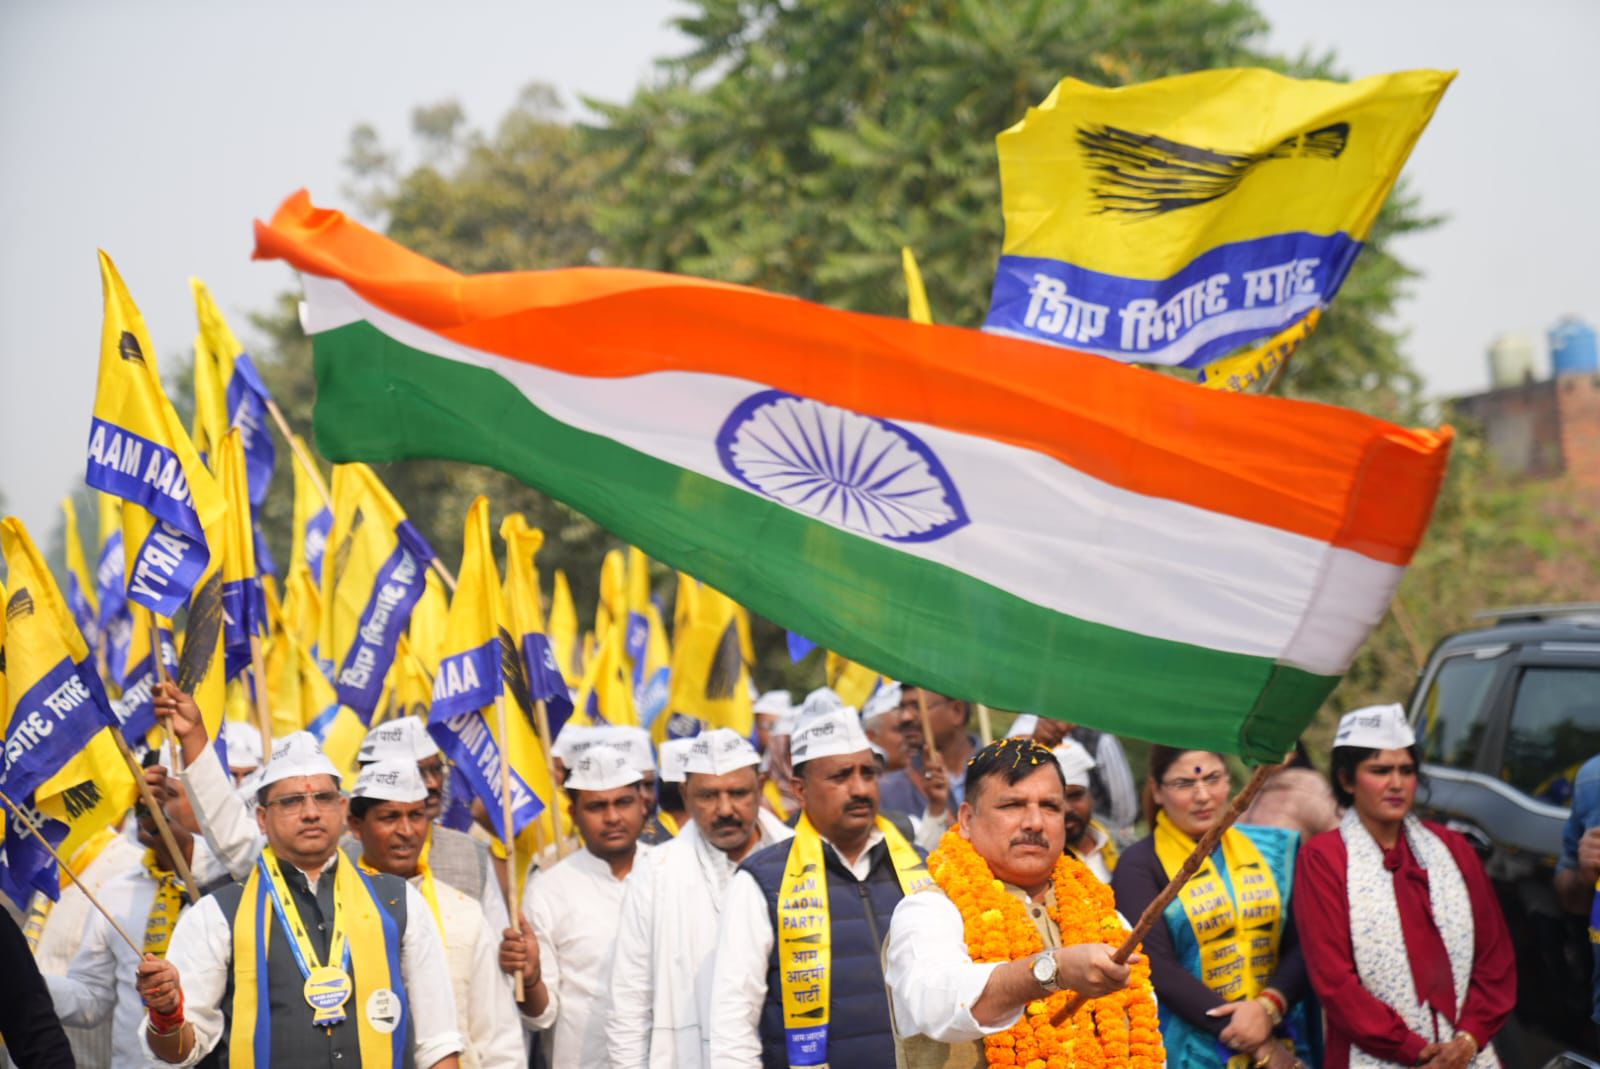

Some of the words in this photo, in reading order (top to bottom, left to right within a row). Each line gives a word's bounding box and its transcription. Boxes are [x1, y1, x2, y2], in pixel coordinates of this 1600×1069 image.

[88, 425, 143, 478] AAM
[792, 879, 816, 893] AAM
[783, 898, 824, 910] AADMI
[783, 915, 824, 929] PARTY
[1197, 911, 1231, 931] PARTY
[792, 949, 818, 963] आम
[787, 963, 825, 984] आदमी
[793, 984, 820, 1003] पार्टी
